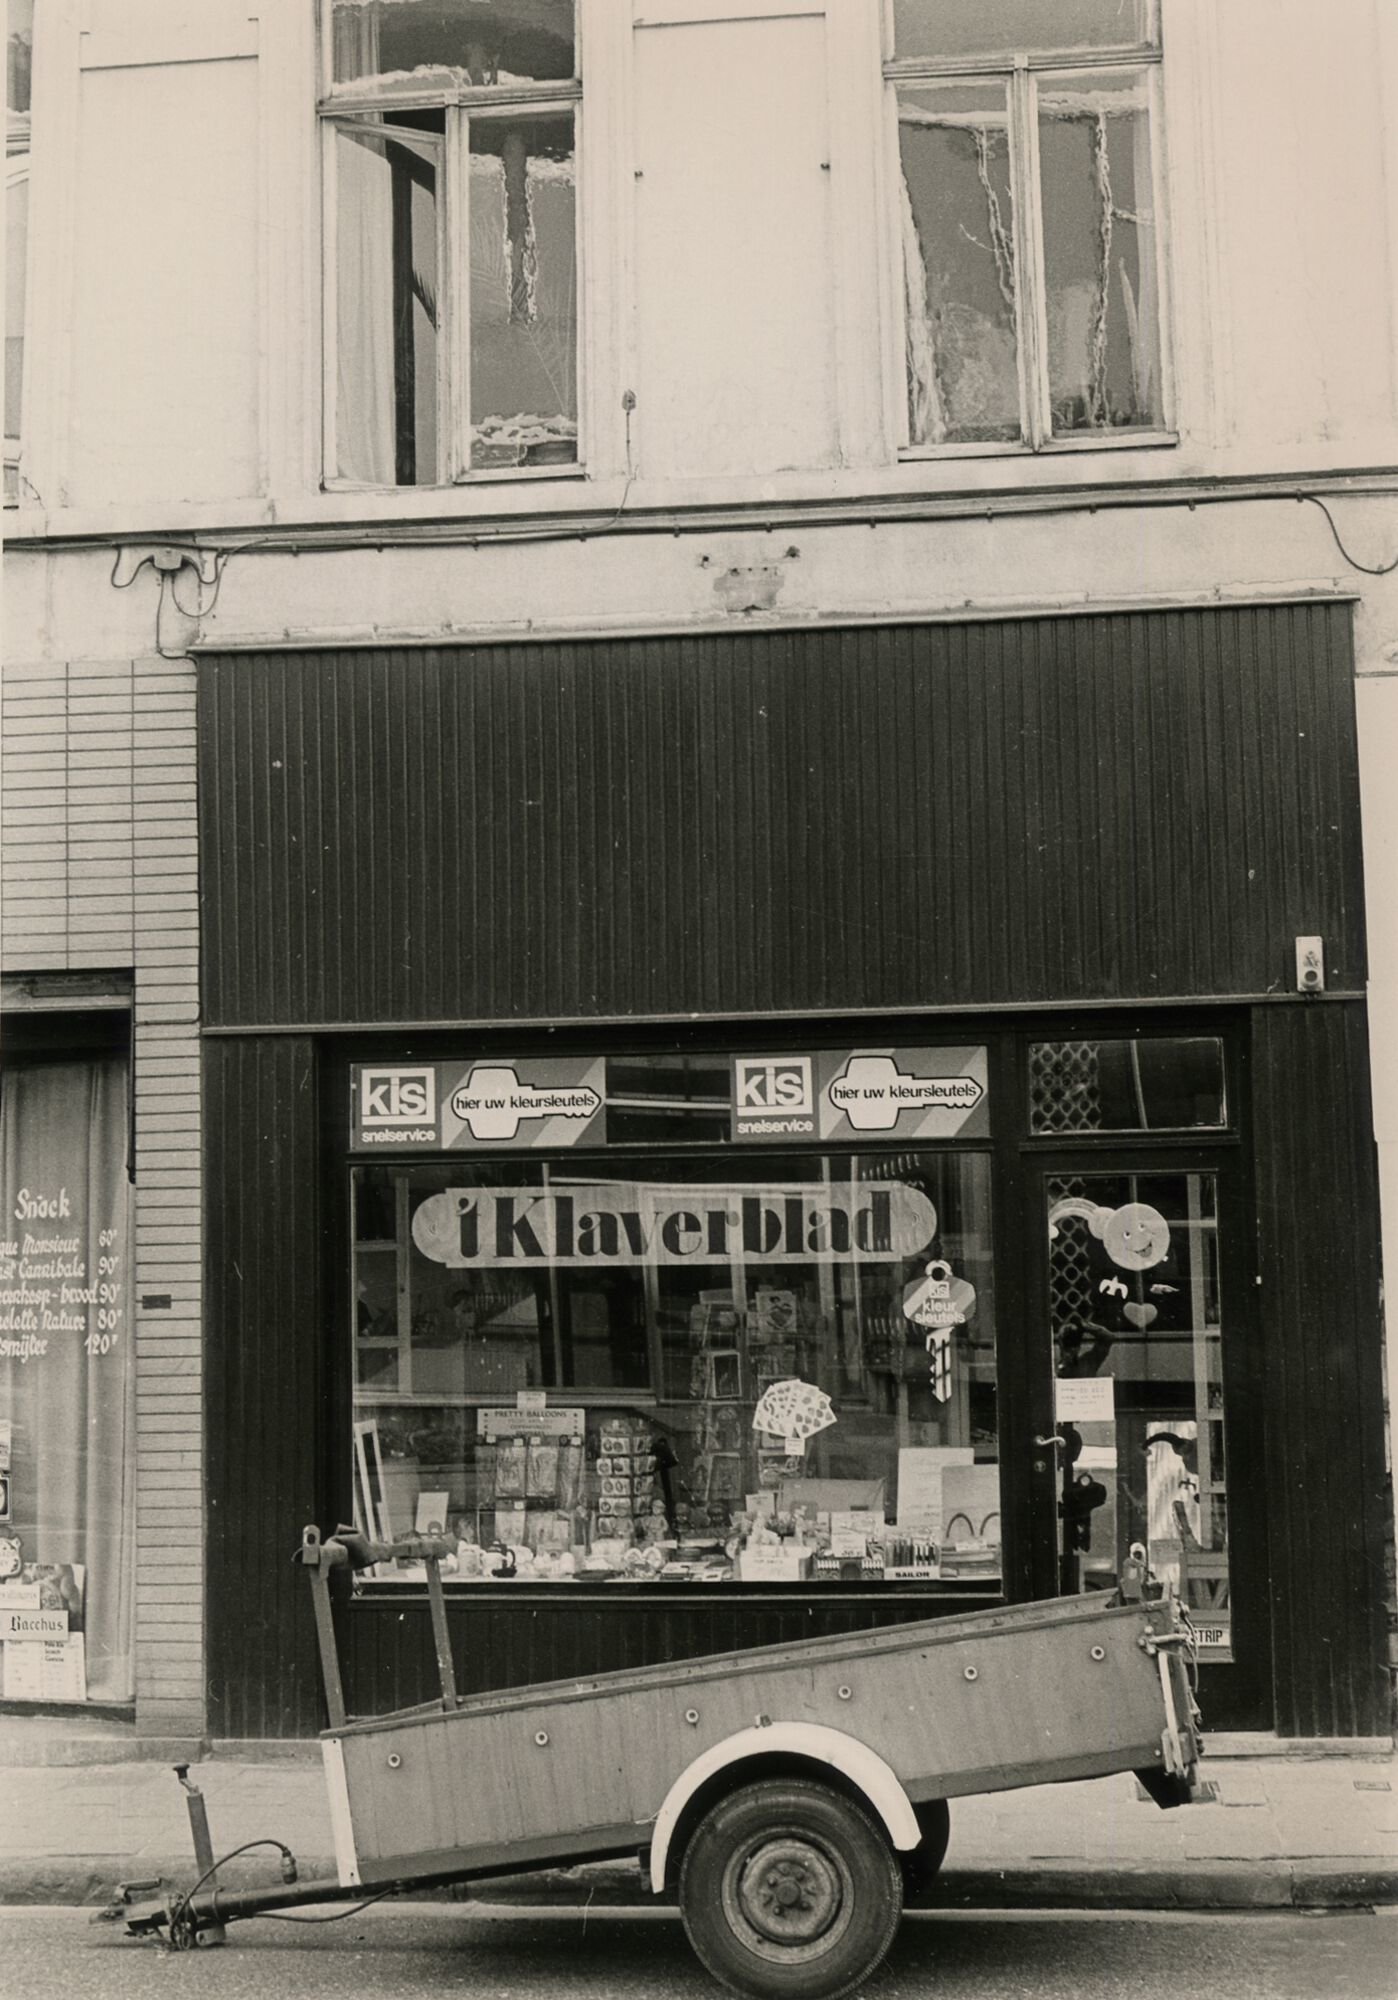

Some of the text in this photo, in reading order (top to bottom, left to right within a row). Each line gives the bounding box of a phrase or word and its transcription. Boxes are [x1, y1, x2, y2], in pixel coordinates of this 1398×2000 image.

[834, 1083, 977, 1099] hier uw kleursleutels
[456, 1093, 596, 1109] hier uw kleursleutels
[737, 1119, 814, 1135] snelservice
[361, 1129, 436, 1143] snelservice
[14, 1187, 71, 1220] Snack
[495, 1191, 893, 1257] Klaverblad
[22, 1233, 80, 1255] Monsieur
[19, 1255, 86, 1279] Cannibale
[922, 1299, 958, 1312] kleur
[41, 1309, 86, 1331] Nature
[914, 1311, 966, 1324] sleutels
[494, 1410, 567, 1418] PRETTY BALLOONS
[10, 1615, 64, 1632] Bacchus
